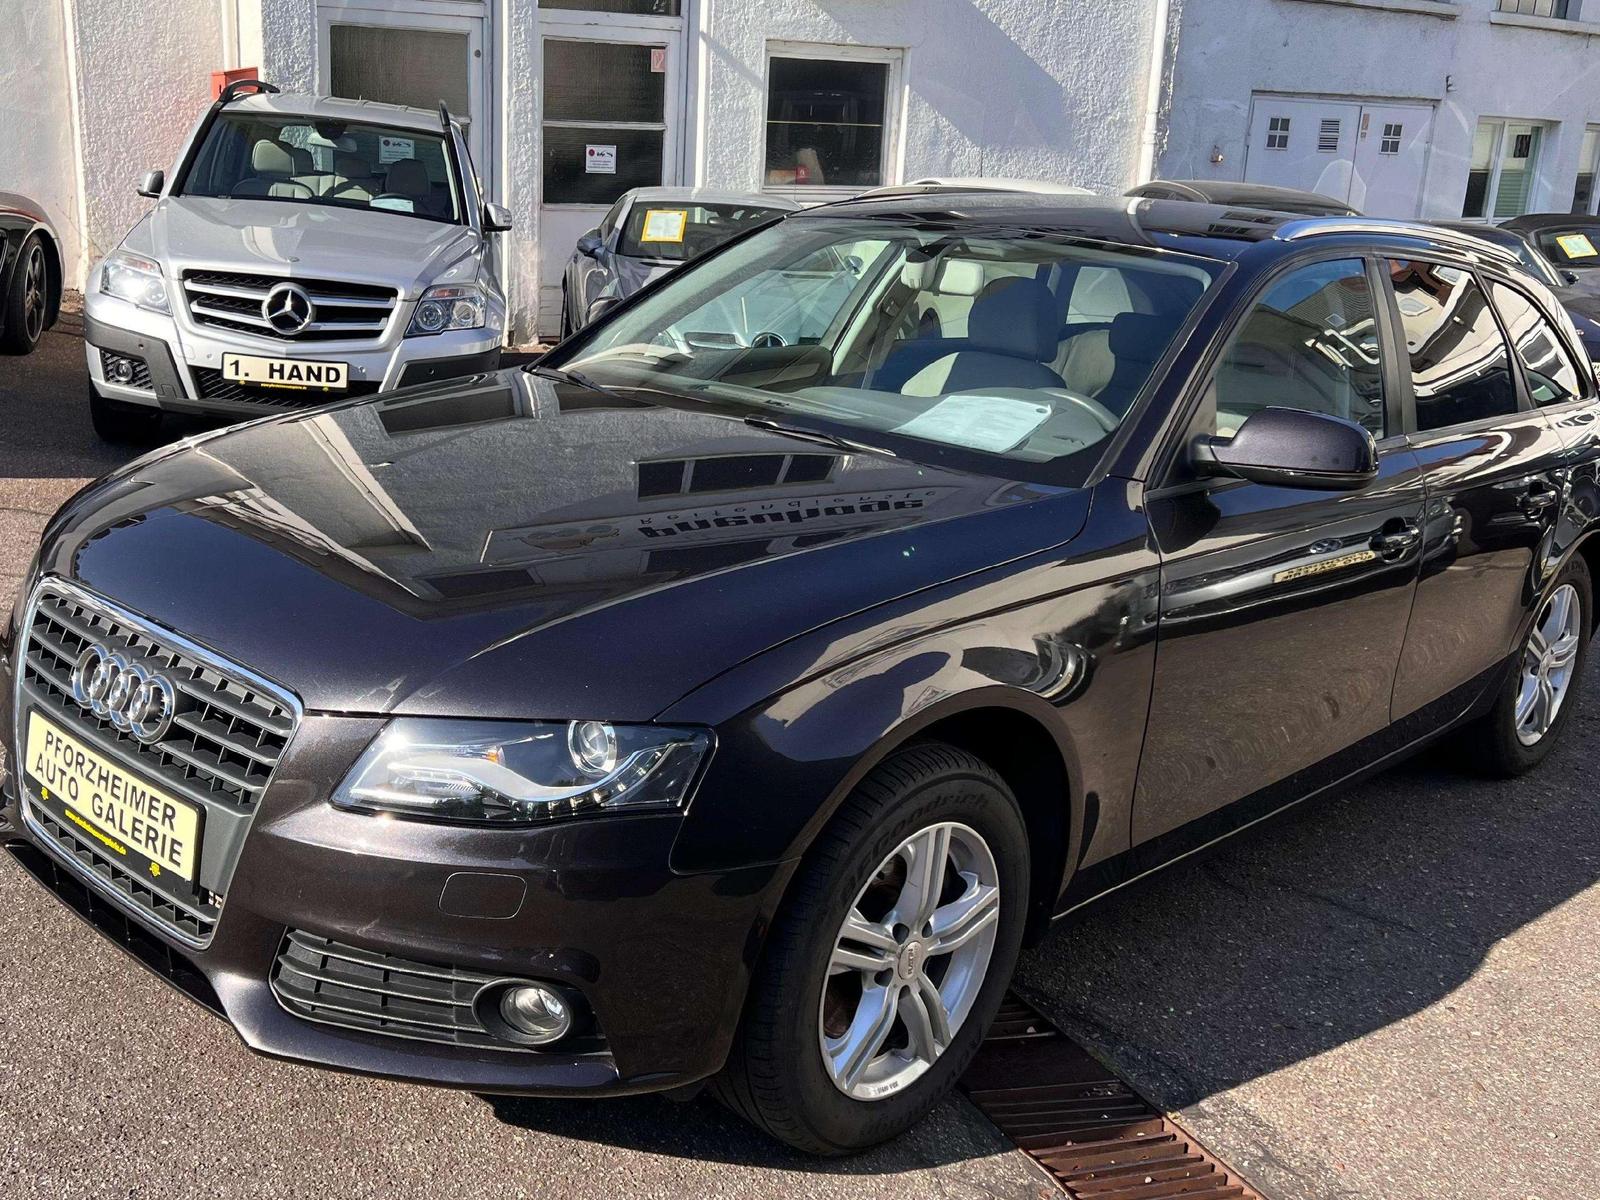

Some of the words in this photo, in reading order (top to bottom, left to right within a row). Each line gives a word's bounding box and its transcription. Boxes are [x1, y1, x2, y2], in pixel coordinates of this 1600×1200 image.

[229, 359, 250, 377] 1.
[268, 362, 341, 383] HAND
[35, 752, 79, 801] AUTO
[91, 792, 183, 868] GALERIE
[45, 730, 177, 832] PFORZHEIMER
